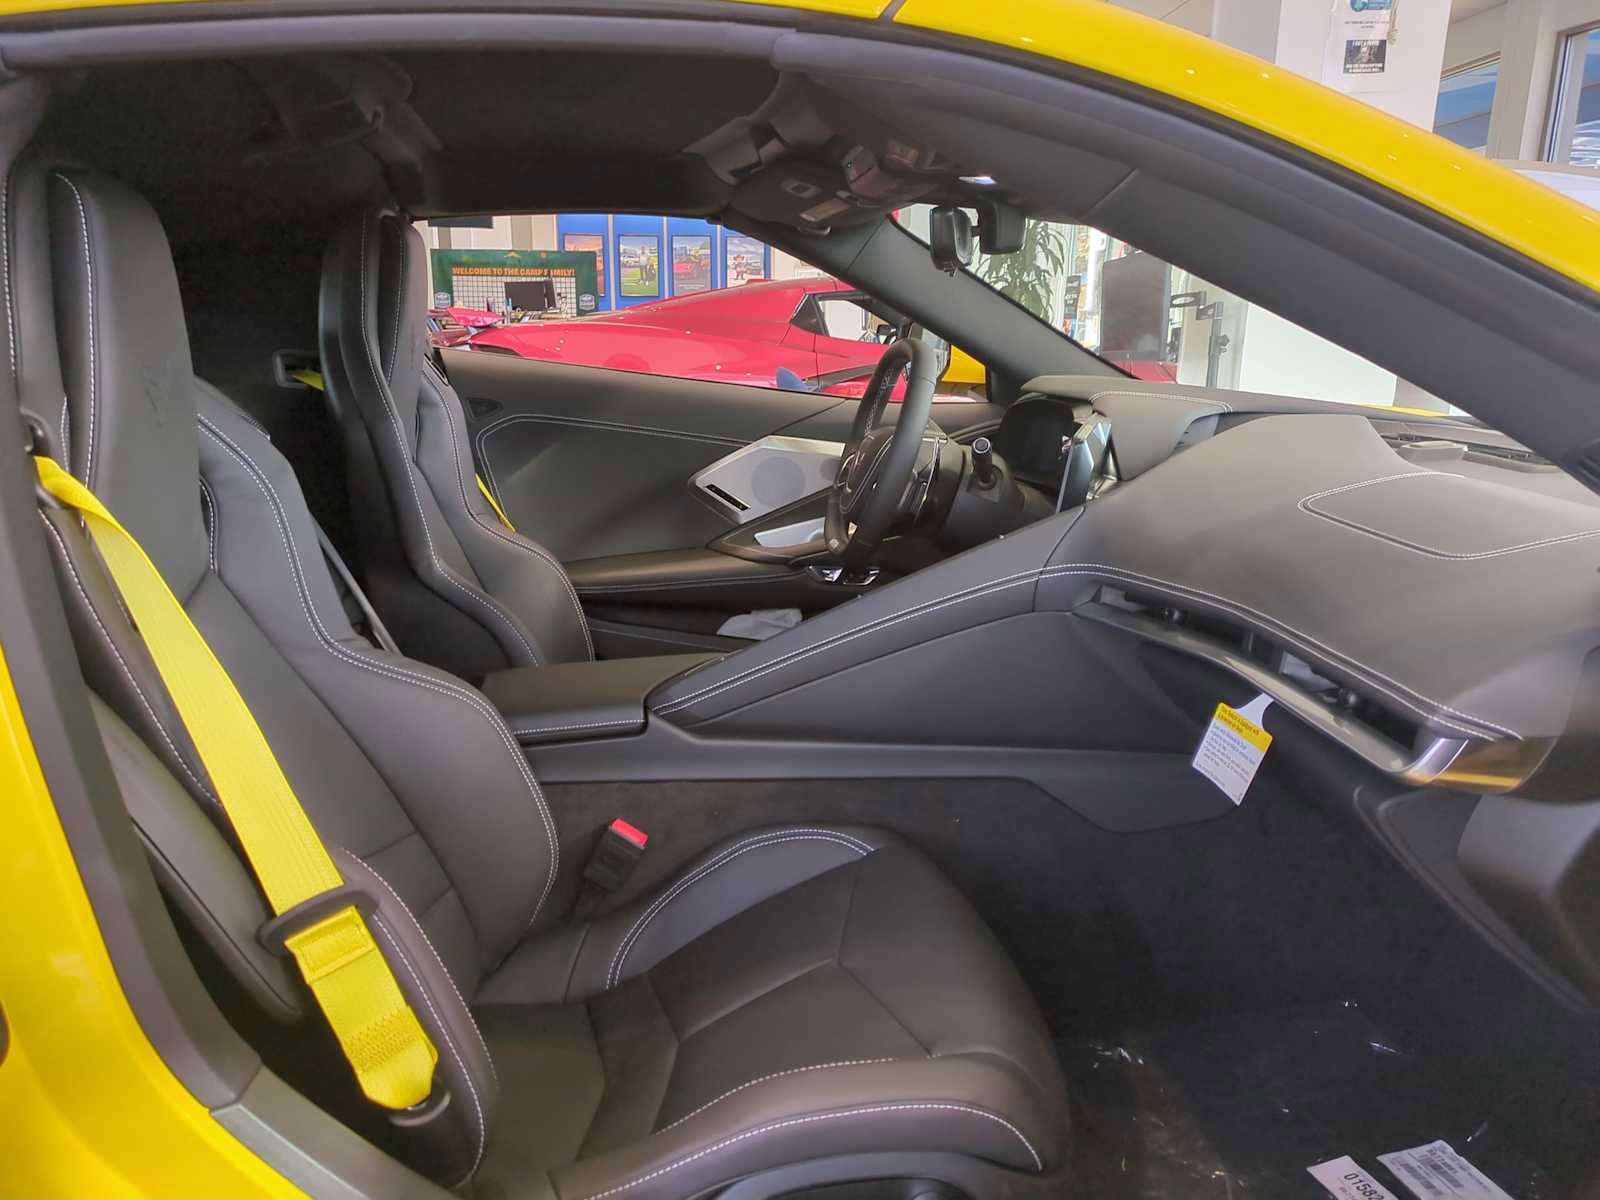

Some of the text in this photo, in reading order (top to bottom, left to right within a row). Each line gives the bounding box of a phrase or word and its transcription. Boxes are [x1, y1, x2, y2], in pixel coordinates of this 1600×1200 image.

[452, 267, 492, 276] WELCOME
[493, 267, 504, 276] TO
[504, 267, 520, 276] THE
[520, 267, 543, 276] CAMP
